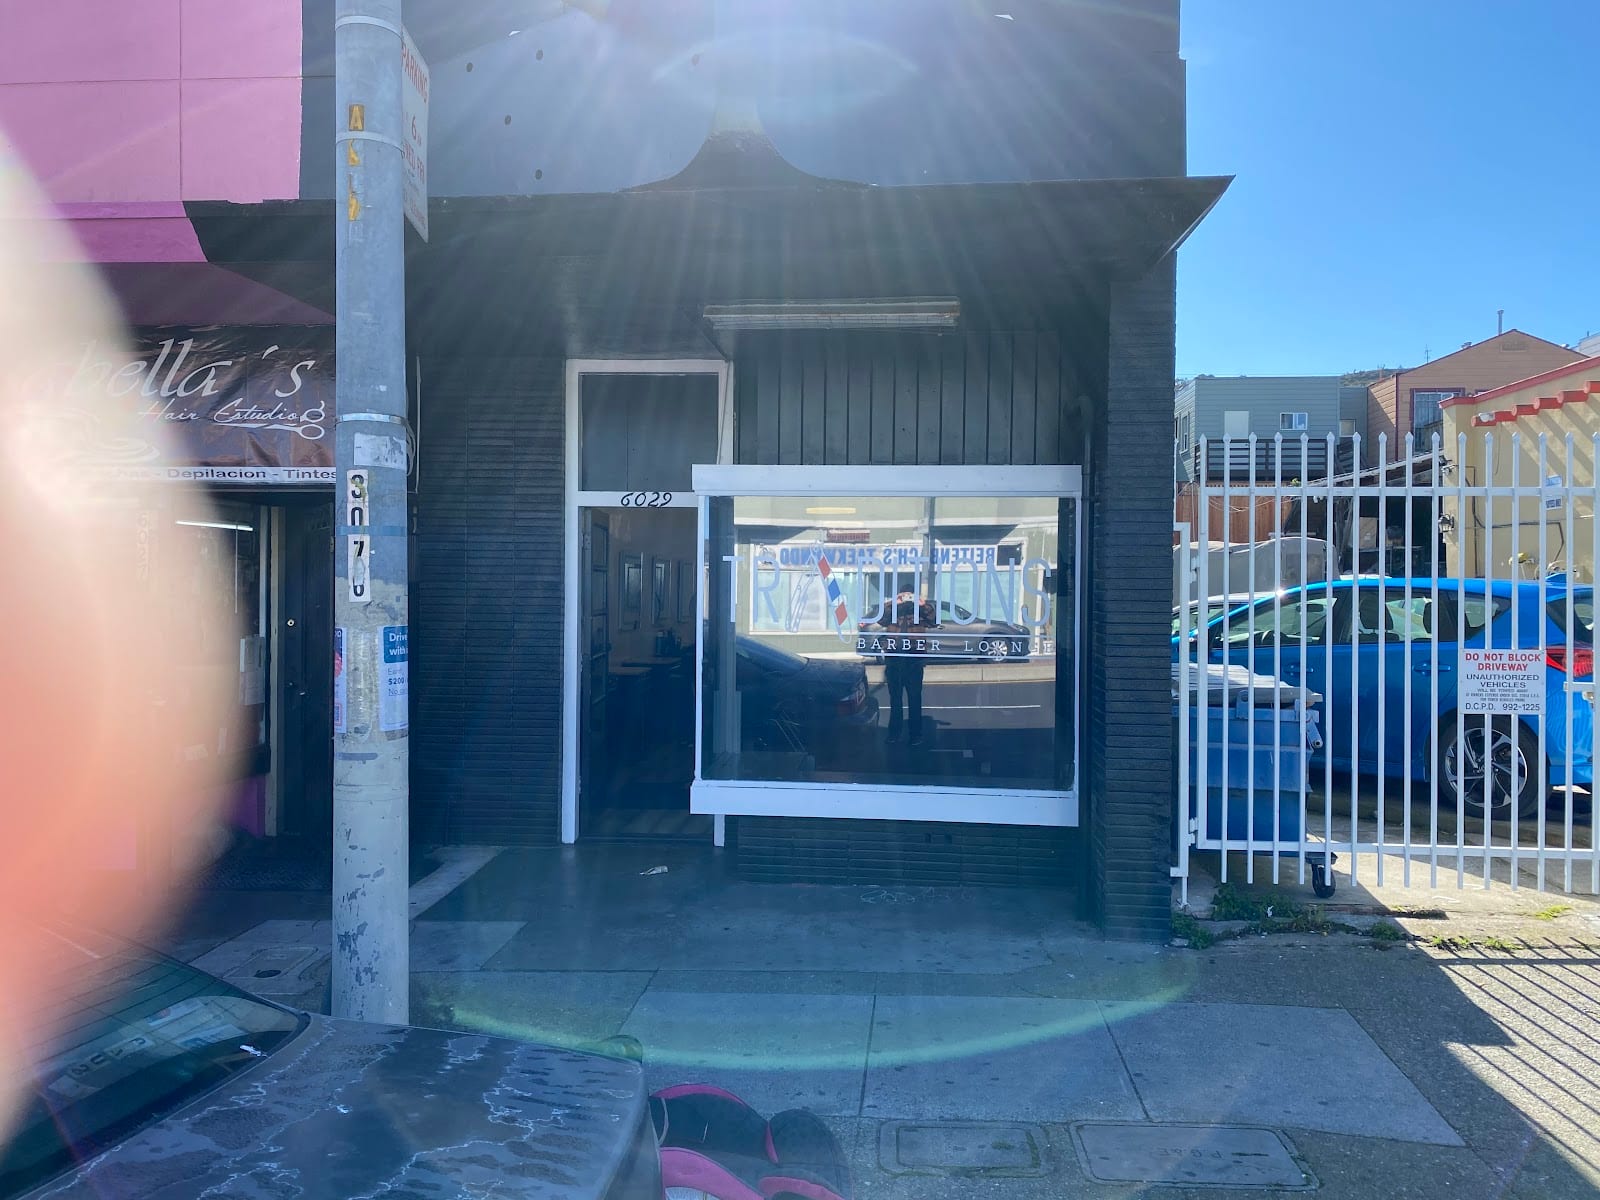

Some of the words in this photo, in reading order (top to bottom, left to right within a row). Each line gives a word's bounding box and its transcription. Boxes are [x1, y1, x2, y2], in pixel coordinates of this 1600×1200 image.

[401, 42, 428, 104] PARKING
[138, 397, 200, 424] Hair
[213, 397, 300, 424] Estudio
[167, 468, 267, 481] Depilacion
[282, 468, 336, 480] Tintes
[620, 491, 672, 507] 6029
[856, 638, 941, 651] BARBER
[964, 640, 1056, 655] LONE
[1465, 652, 1479, 661] DO
[1484, 653, 1504, 662] NOT
[1508, 653, 1541, 662] BLOCK
[1477, 663, 1528, 671] DRIVEWAY
[1465, 702, 1496, 711] D.C.P.D.
[1502, 703, 1541, 711] 992-1225
